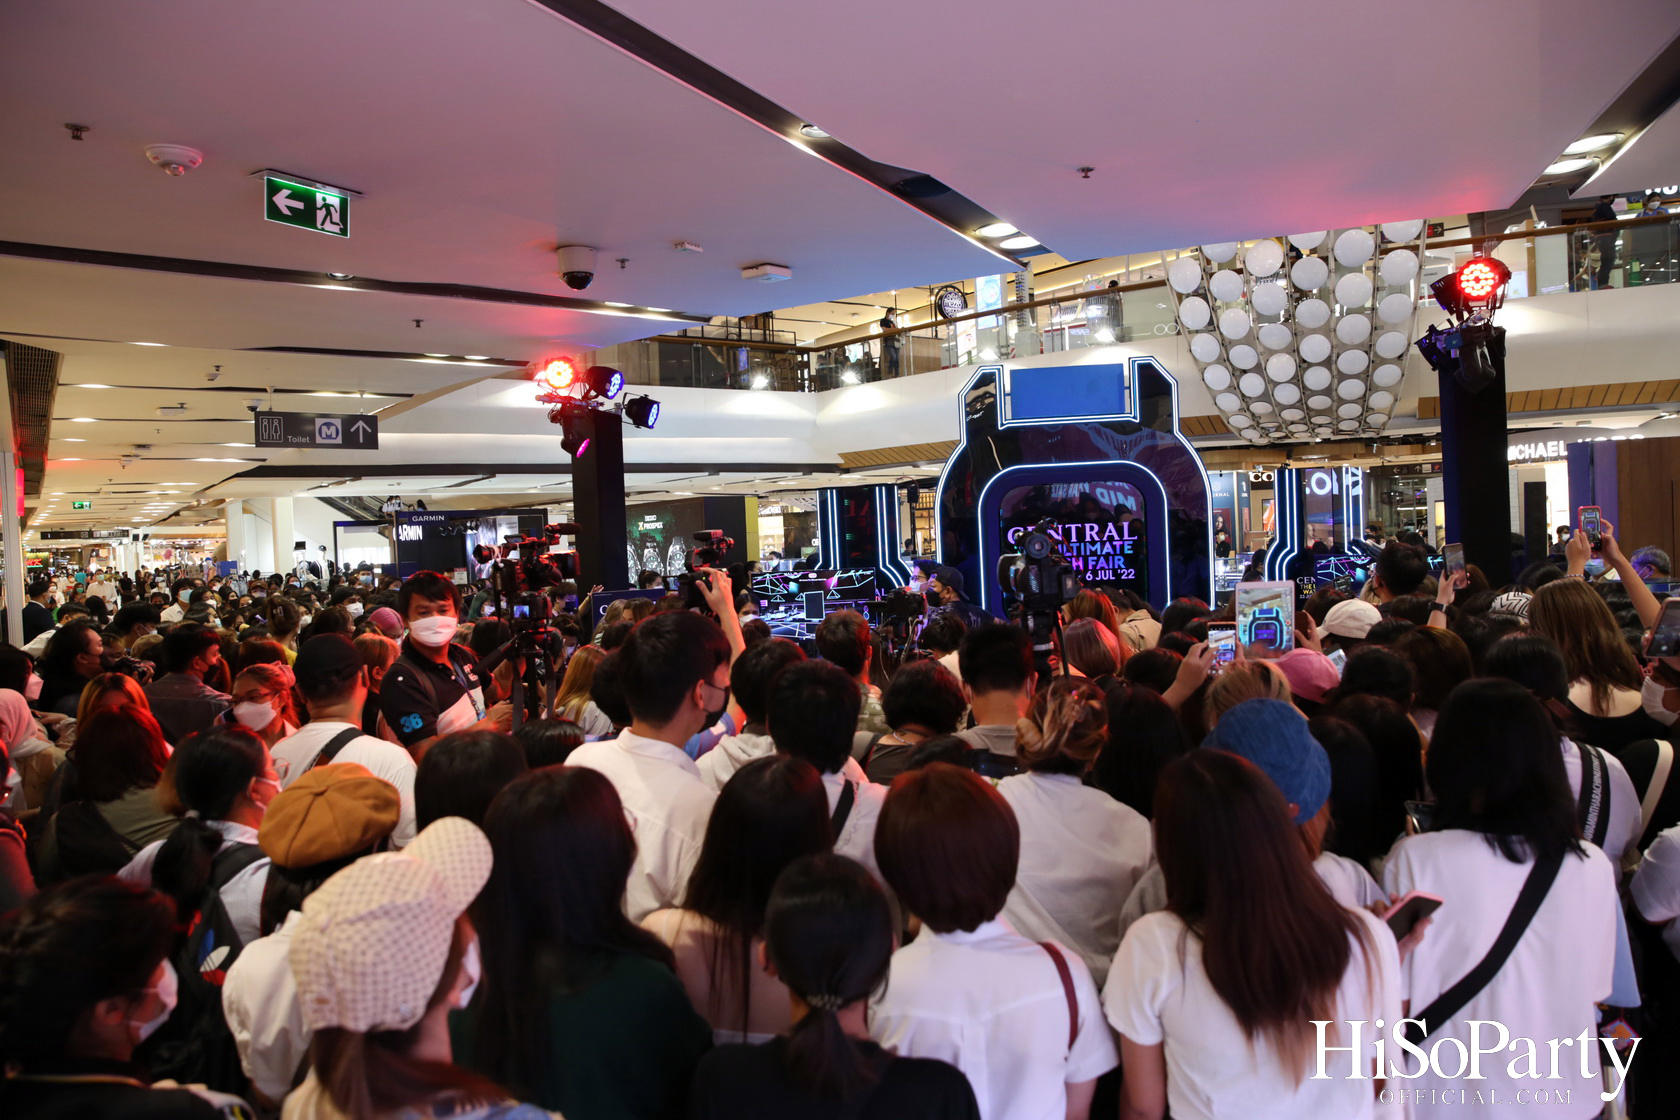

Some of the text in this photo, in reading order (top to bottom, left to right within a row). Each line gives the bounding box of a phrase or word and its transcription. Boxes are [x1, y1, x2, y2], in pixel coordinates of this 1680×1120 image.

[287, 435, 310, 443] Toilet
[643, 522, 663, 530] PROSPEX
[1007, 521, 1138, 545] CNTRAL
[1088, 556, 1126, 570] FAIR
[1095, 569, 1115, 580] JUL
[400, 713, 423, 733] 36
